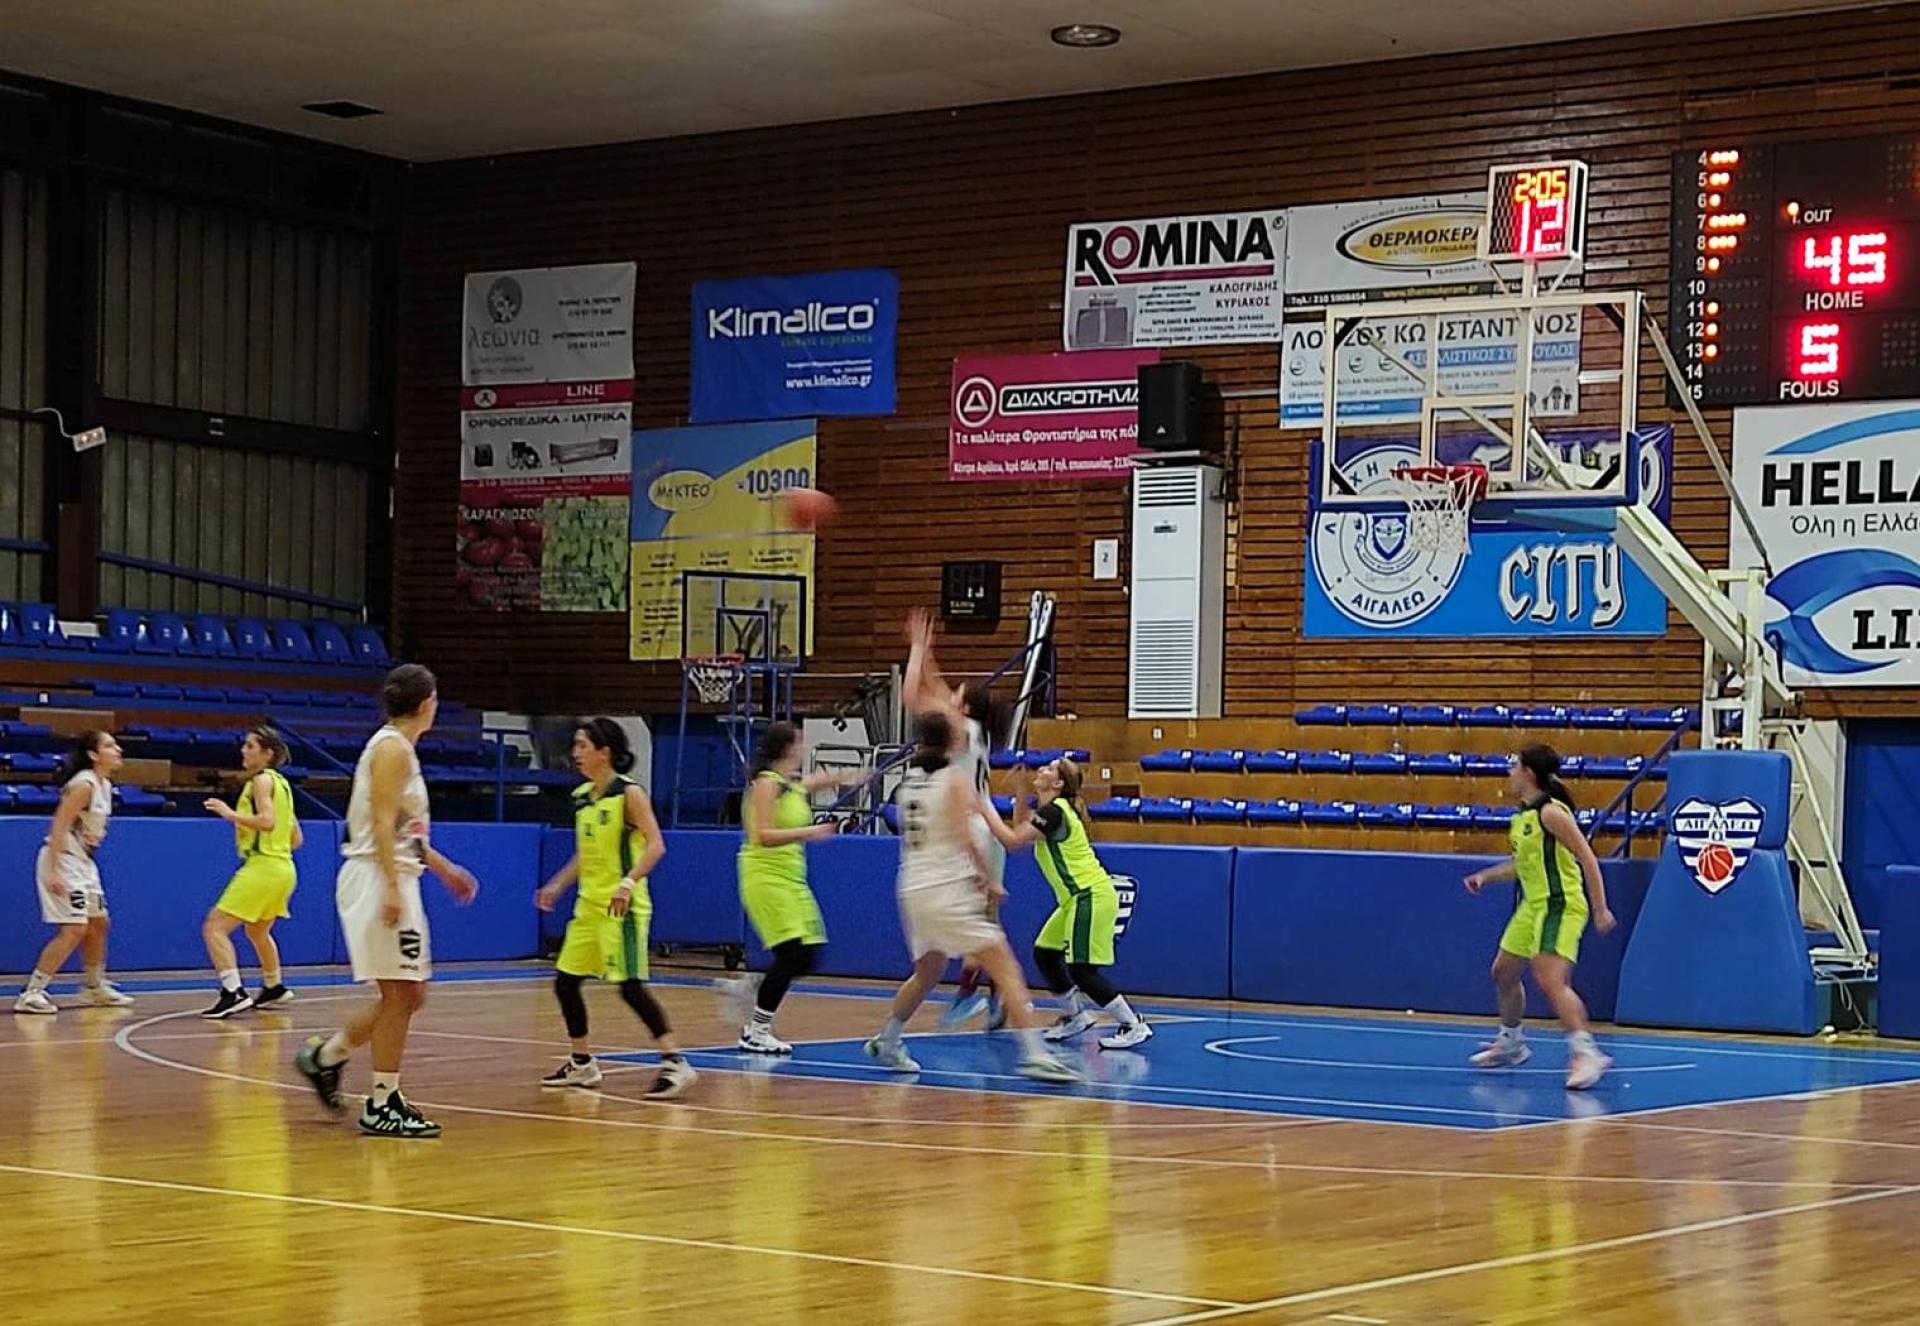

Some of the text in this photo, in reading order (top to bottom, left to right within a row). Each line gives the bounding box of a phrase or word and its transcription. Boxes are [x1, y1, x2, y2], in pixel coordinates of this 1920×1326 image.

[1697, 151, 1707, 166] 4
[1515, 170, 1567, 202] 2:05
[1697, 172, 1708, 187] 5
[1697, 193, 1707, 208] 6
[1697, 214, 1707, 229] 7
[1804, 209, 1833, 223] OUT
[1520, 198, 1564, 255] 12
[1696, 235, 1706, 250] 8
[1075, 217, 1275, 286] ROMINA
[1804, 232, 1887, 285] 45
[1696, 256, 1706, 271] 9
[1209, 280, 1279, 294] ΚΑΛΟΓΡΙΔΗΣ
[1688, 280, 1705, 295] 10
[1216, 297, 1271, 309] ΚΥΡΙΑΚΟΣ
[1687, 301, 1704, 316] 11
[1805, 291, 1864, 311] HOME
[709, 301, 875, 339] Klimallco
[1291, 325, 1387, 350] ΛΟΖΟΣ
[1394, 313, 1577, 344] ΚΩΣΤΑΝΤΝΟΣ
[1686, 322, 1704, 337] 12
[1686, 342, 1704, 358] 13
[1800, 324, 1840, 375] 5
[1685, 363, 1703, 379] 14
[566, 384, 605, 397] LINE
[1780, 380, 1840, 400] FOULS
[468, 415, 560, 429] ΟΡΘΟΠΕΔΙΚΑ
[572, 411, 627, 424] ΙΑΤΡΙΚΑ
[955, 433, 968, 444] Τα
[1022, 427, 1098, 444] Φροντιστήρια
[1099, 428, 1118, 441] της
[1790, 514, 1836, 538] Όλη
[1843, 518, 1856, 538] η
[1499, 543, 1626, 628] CITY
[1351, 590, 1426, 615] ΑΙΓΑΛΕΩ
[1852, 609, 1920, 650] LI
